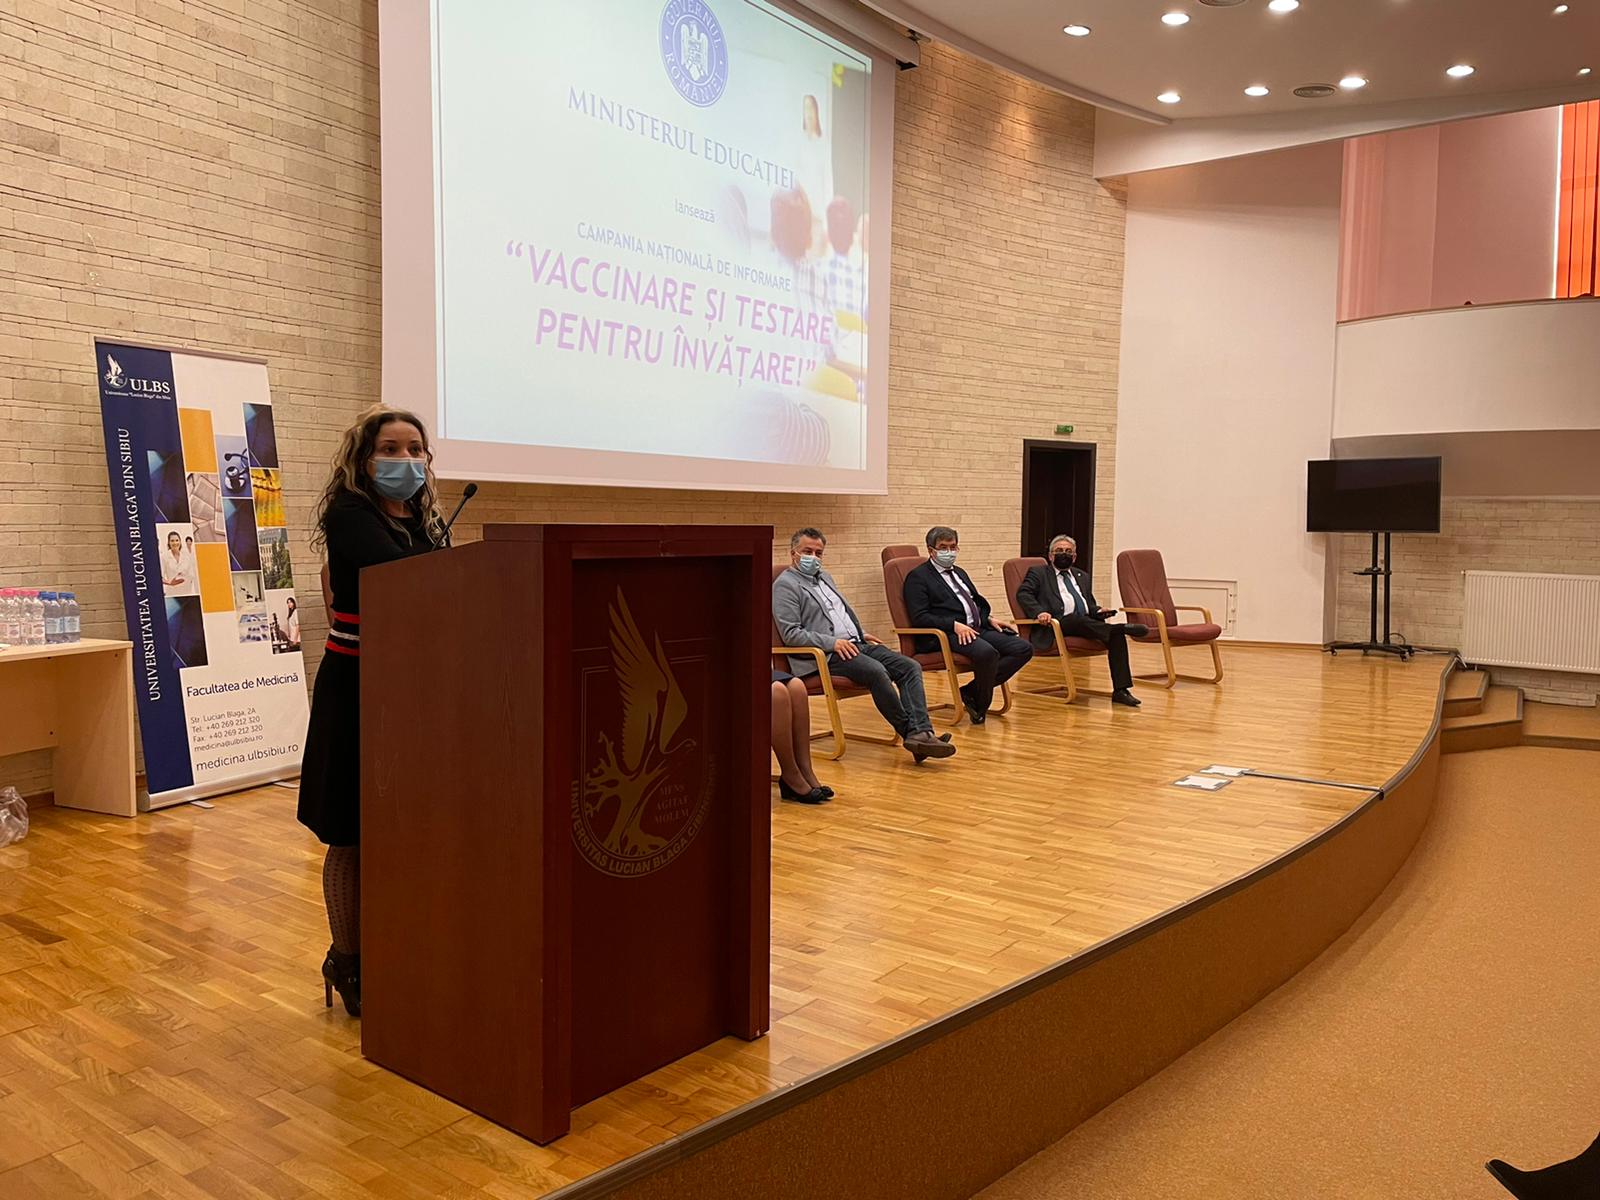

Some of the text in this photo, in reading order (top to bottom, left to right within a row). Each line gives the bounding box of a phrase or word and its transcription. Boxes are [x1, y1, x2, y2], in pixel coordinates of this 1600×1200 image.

[568, 86, 794, 190] MINISTERUL EDUCAȚIEI
[674, 198, 715, 223] lansează
[577, 222, 791, 293] CAMPANIA NAȚIONALĂ DE INFORMARE
[705, 287, 725, 332] ȘI
[735, 294, 834, 346] TESTARE
[534, 308, 664, 364] PENTRU
[130, 378, 171, 394] ULBS
[118, 428, 132, 462] SIBIU
[122, 464, 135, 489] DIN
[138, 598, 161, 701] UNIVERSITATEA
[186, 672, 299, 697] Facultatea de Medicină
[203, 713, 226, 722] Lucian
[221, 720, 234, 728] 269
[235, 718, 247, 726] 212
[194, 735, 264, 752] medicina@ulbsibiu.ro
[224, 729, 237, 737] 269
[238, 727, 249, 735] 212
[196, 743, 299, 771] medicina.ulbsibiu.ro
[571, 779, 689, 874] UNIVERSITAS LUCIAN BLAGA
